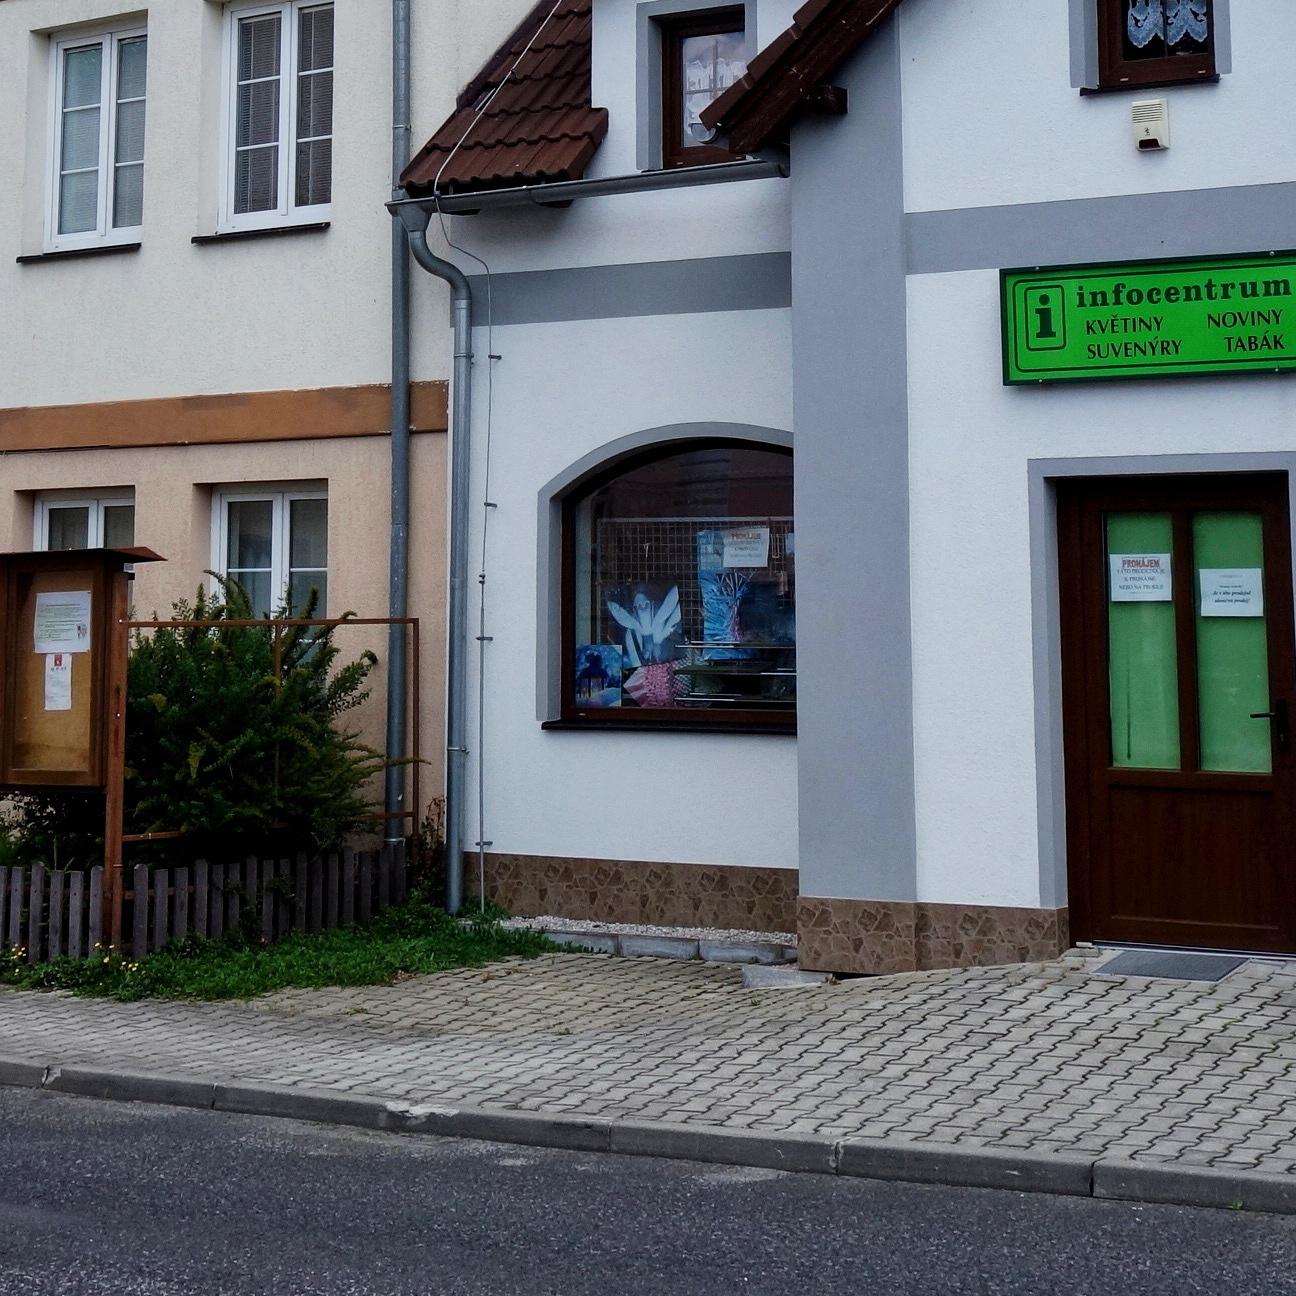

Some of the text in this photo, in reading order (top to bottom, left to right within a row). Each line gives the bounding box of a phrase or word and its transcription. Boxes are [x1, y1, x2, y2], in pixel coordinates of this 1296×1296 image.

[1076, 276, 1292, 308] infocentrum
[1086, 309, 1284, 336] KVĚTINY NOVINY
[1087, 330, 1286, 360] SUVENÝRY TABÁK
